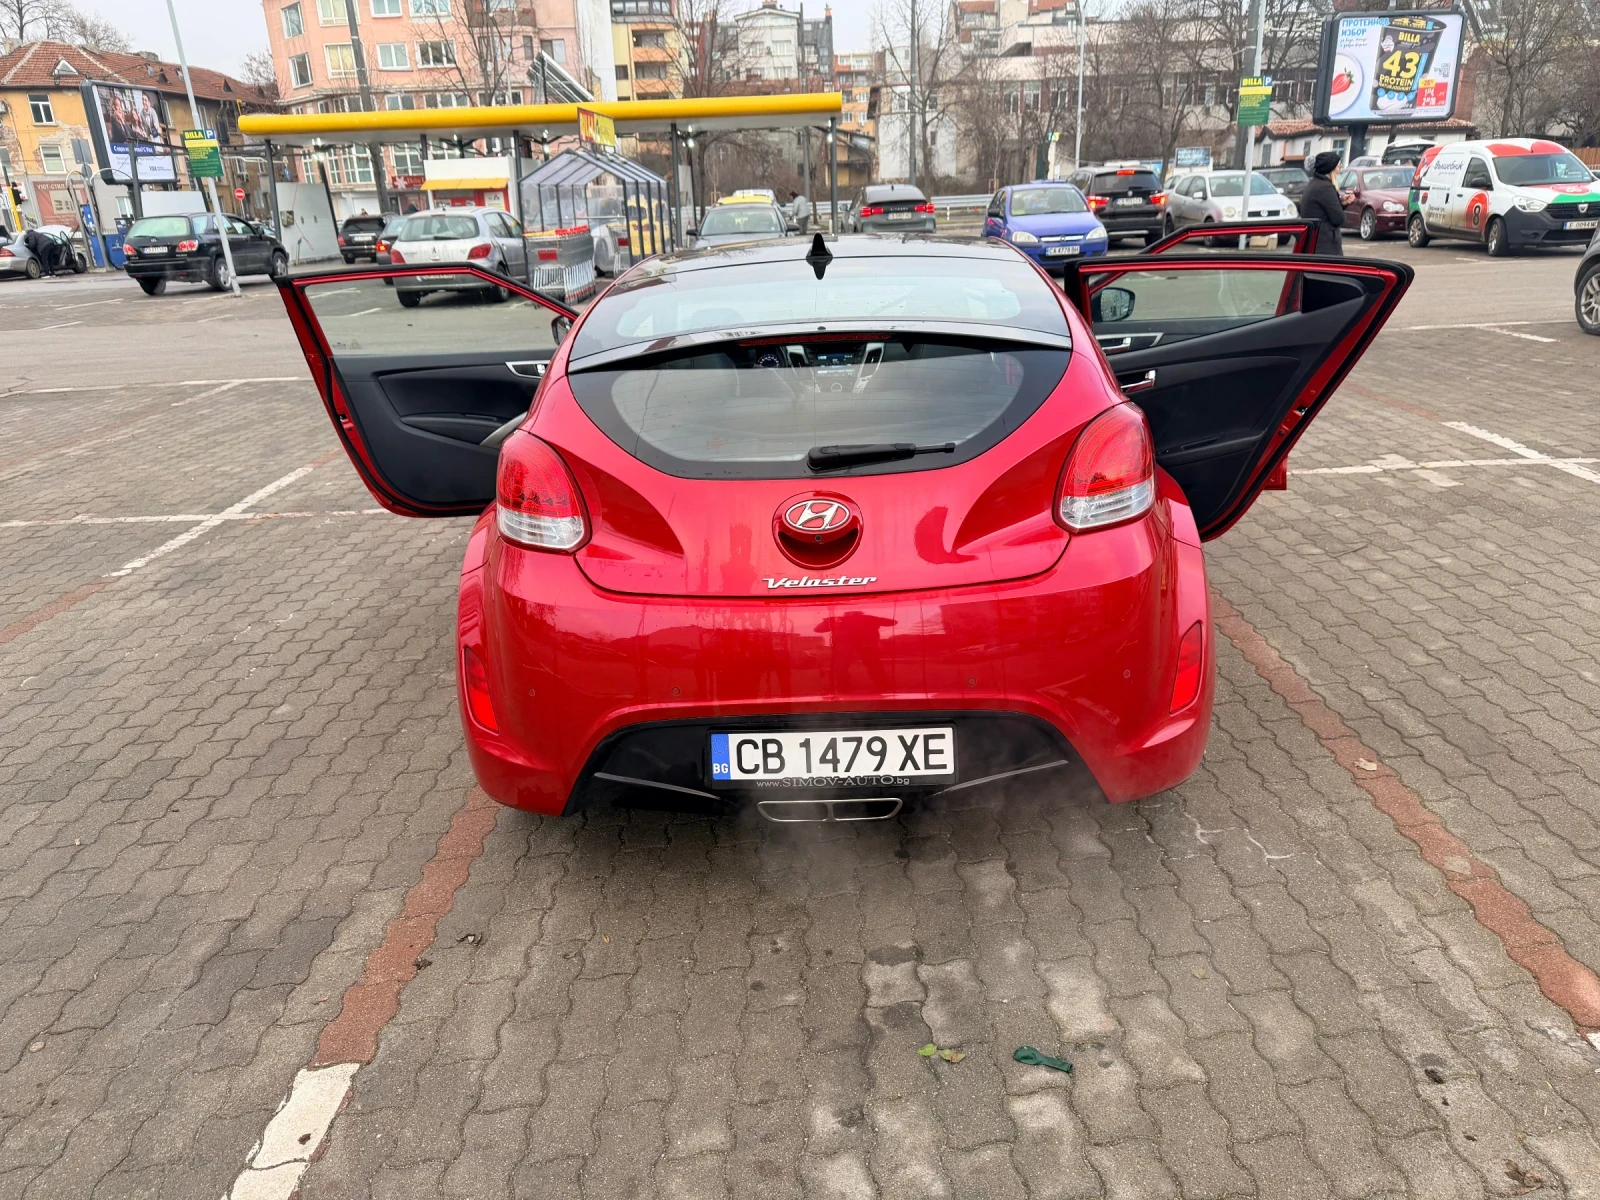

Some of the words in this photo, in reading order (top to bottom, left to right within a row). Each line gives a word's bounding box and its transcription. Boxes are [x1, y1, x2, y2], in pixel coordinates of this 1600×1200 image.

[1341, 28, 1367, 36] ИЗБОР
[1398, 31, 1420, 43] BILLA
[1383, 50, 1420, 79] 43
[1242, 77, 1263, 86] BILLA
[1265, 76, 1272, 85] P
[1380, 74, 1414, 87] PROTEIN
[184, 131, 204, 139] BILLA
[206, 130, 214, 138] P
[762, 576, 877, 589] Veloster
[736, 738, 786, 774] CB
[799, 736, 888, 774] 1479
[897, 733, 948, 772] XE
[713, 763, 729, 774] BG
[756, 775, 910, 788] www.SIMOV-AUTO.bg
